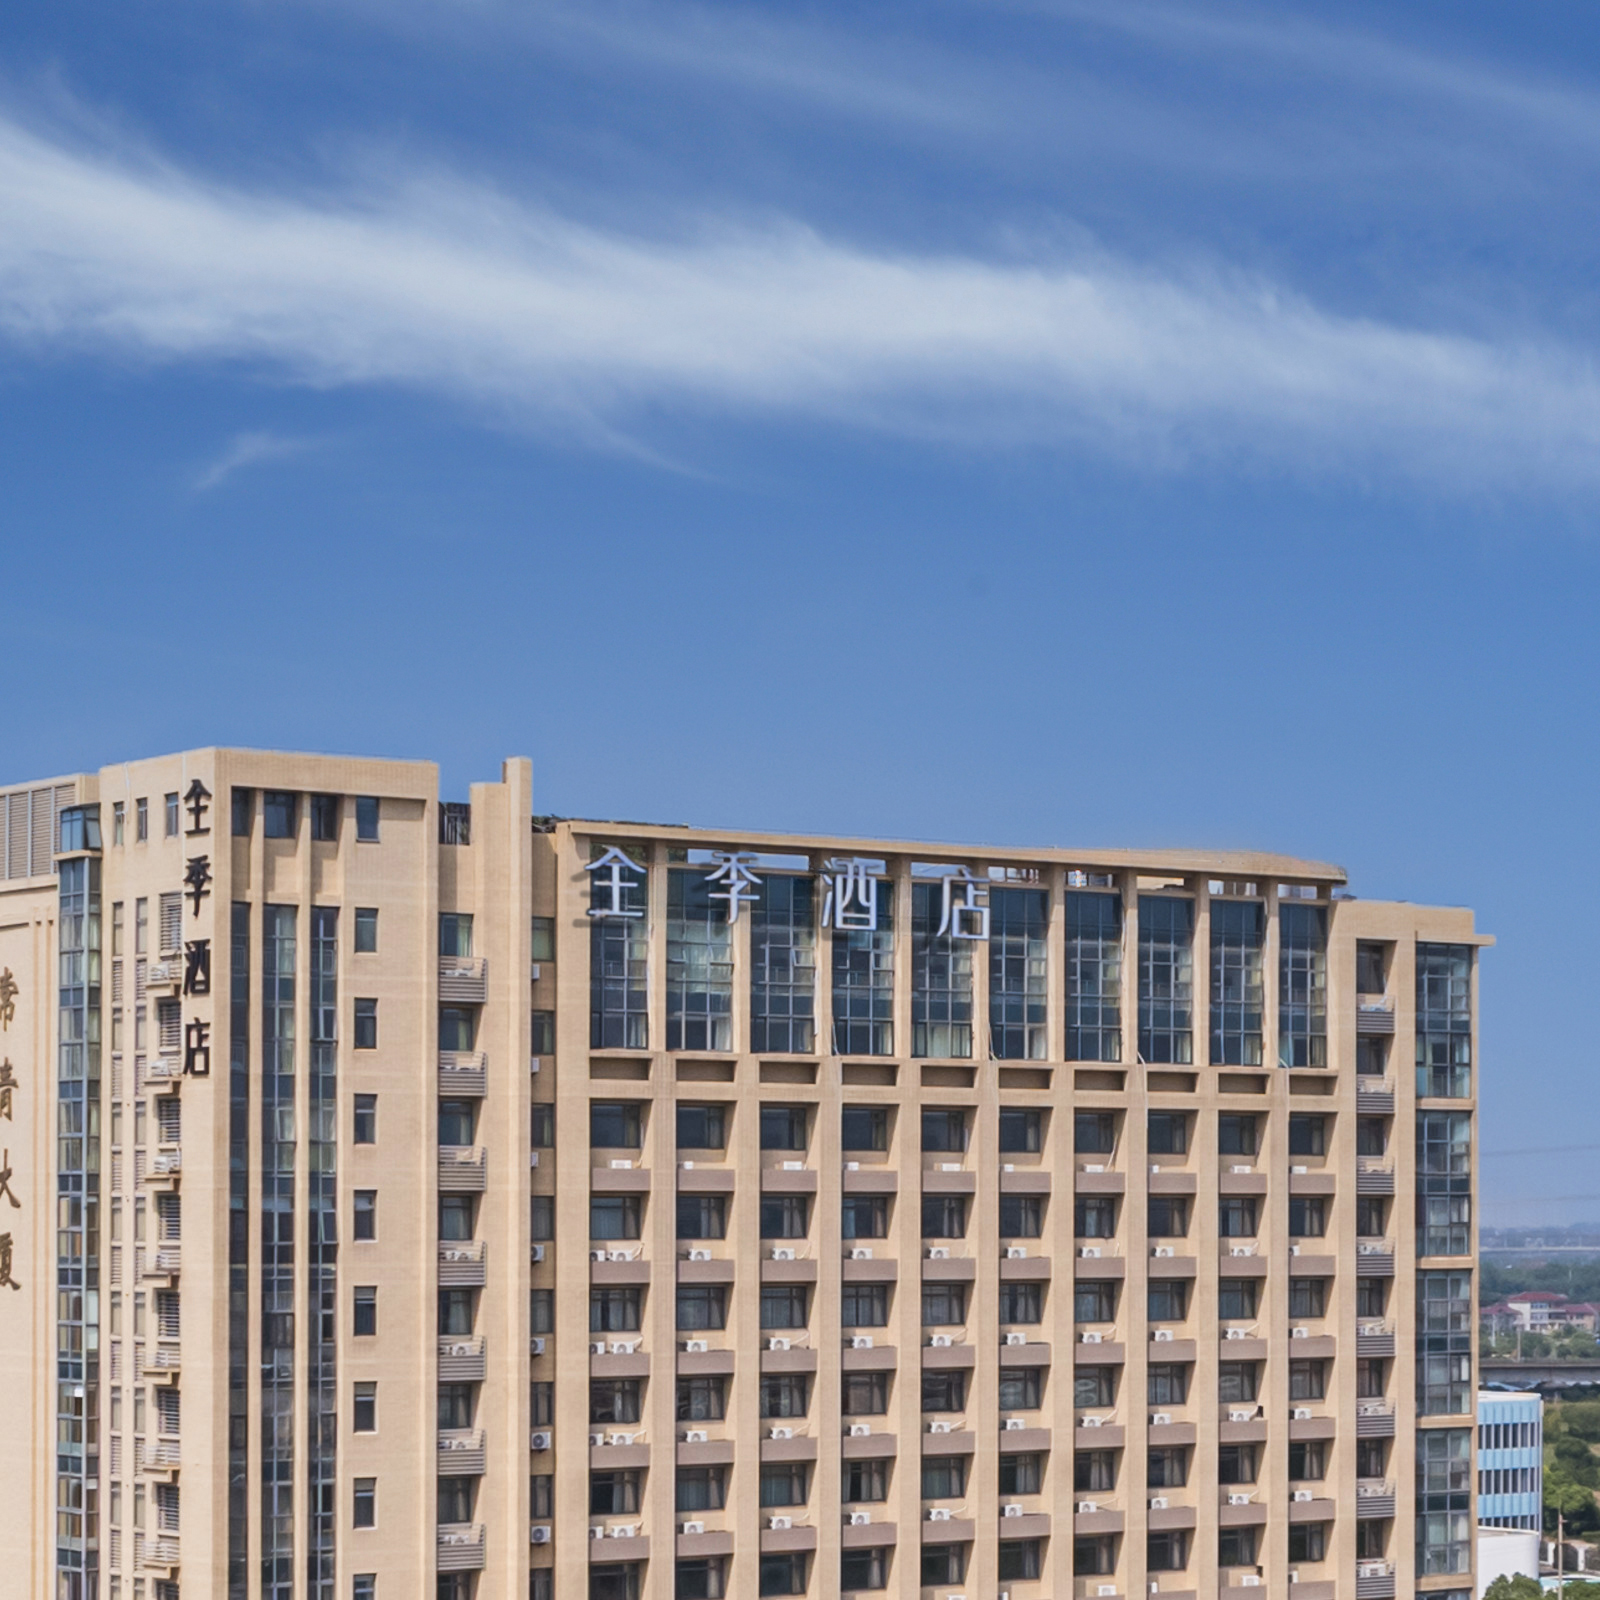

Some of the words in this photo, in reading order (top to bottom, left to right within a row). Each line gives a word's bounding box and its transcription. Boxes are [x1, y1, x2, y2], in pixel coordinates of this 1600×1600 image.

[183, 778, 212, 1077] 全季酒店
[584, 845, 991, 942] 全季酒店
